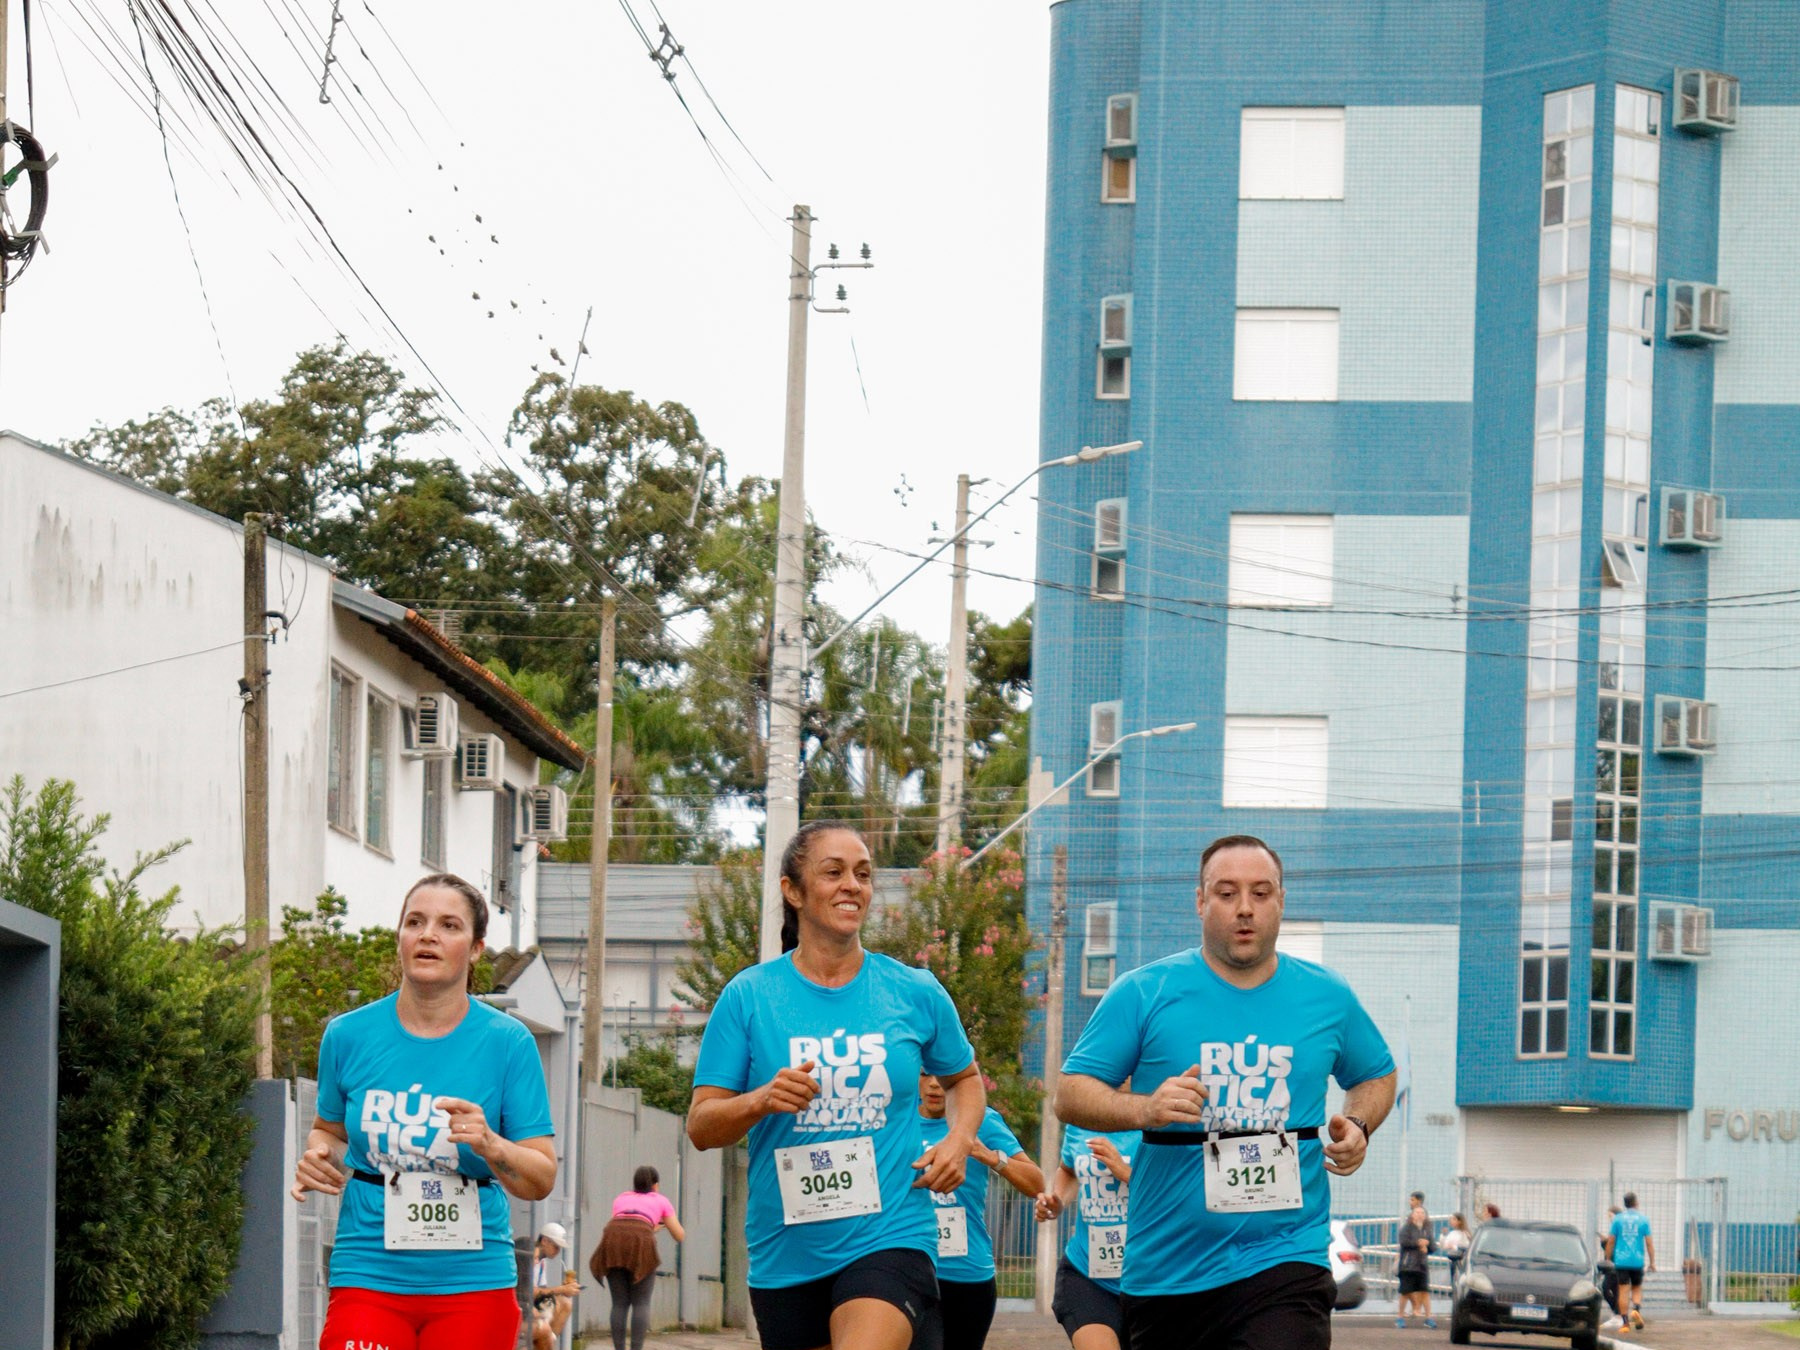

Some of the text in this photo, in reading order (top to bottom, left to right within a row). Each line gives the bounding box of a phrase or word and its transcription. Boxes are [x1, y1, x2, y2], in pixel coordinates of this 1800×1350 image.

[789, 1028, 888, 1067] RÚS
[1201, 1034, 1294, 1078] RÚS
[808, 1063, 893, 1101] ICA
[1201, 1074, 1291, 1111] TICA
[361, 1121, 459, 1160] TICA
[845, 1153, 857, 1162] 3K
[1272, 1149, 1283, 1157] 3K
[800, 1171, 853, 1195] 3049
[1226, 1165, 1276, 1187] 3121
[454, 1187, 465, 1196] 3K
[407, 1203, 459, 1222] 3086
